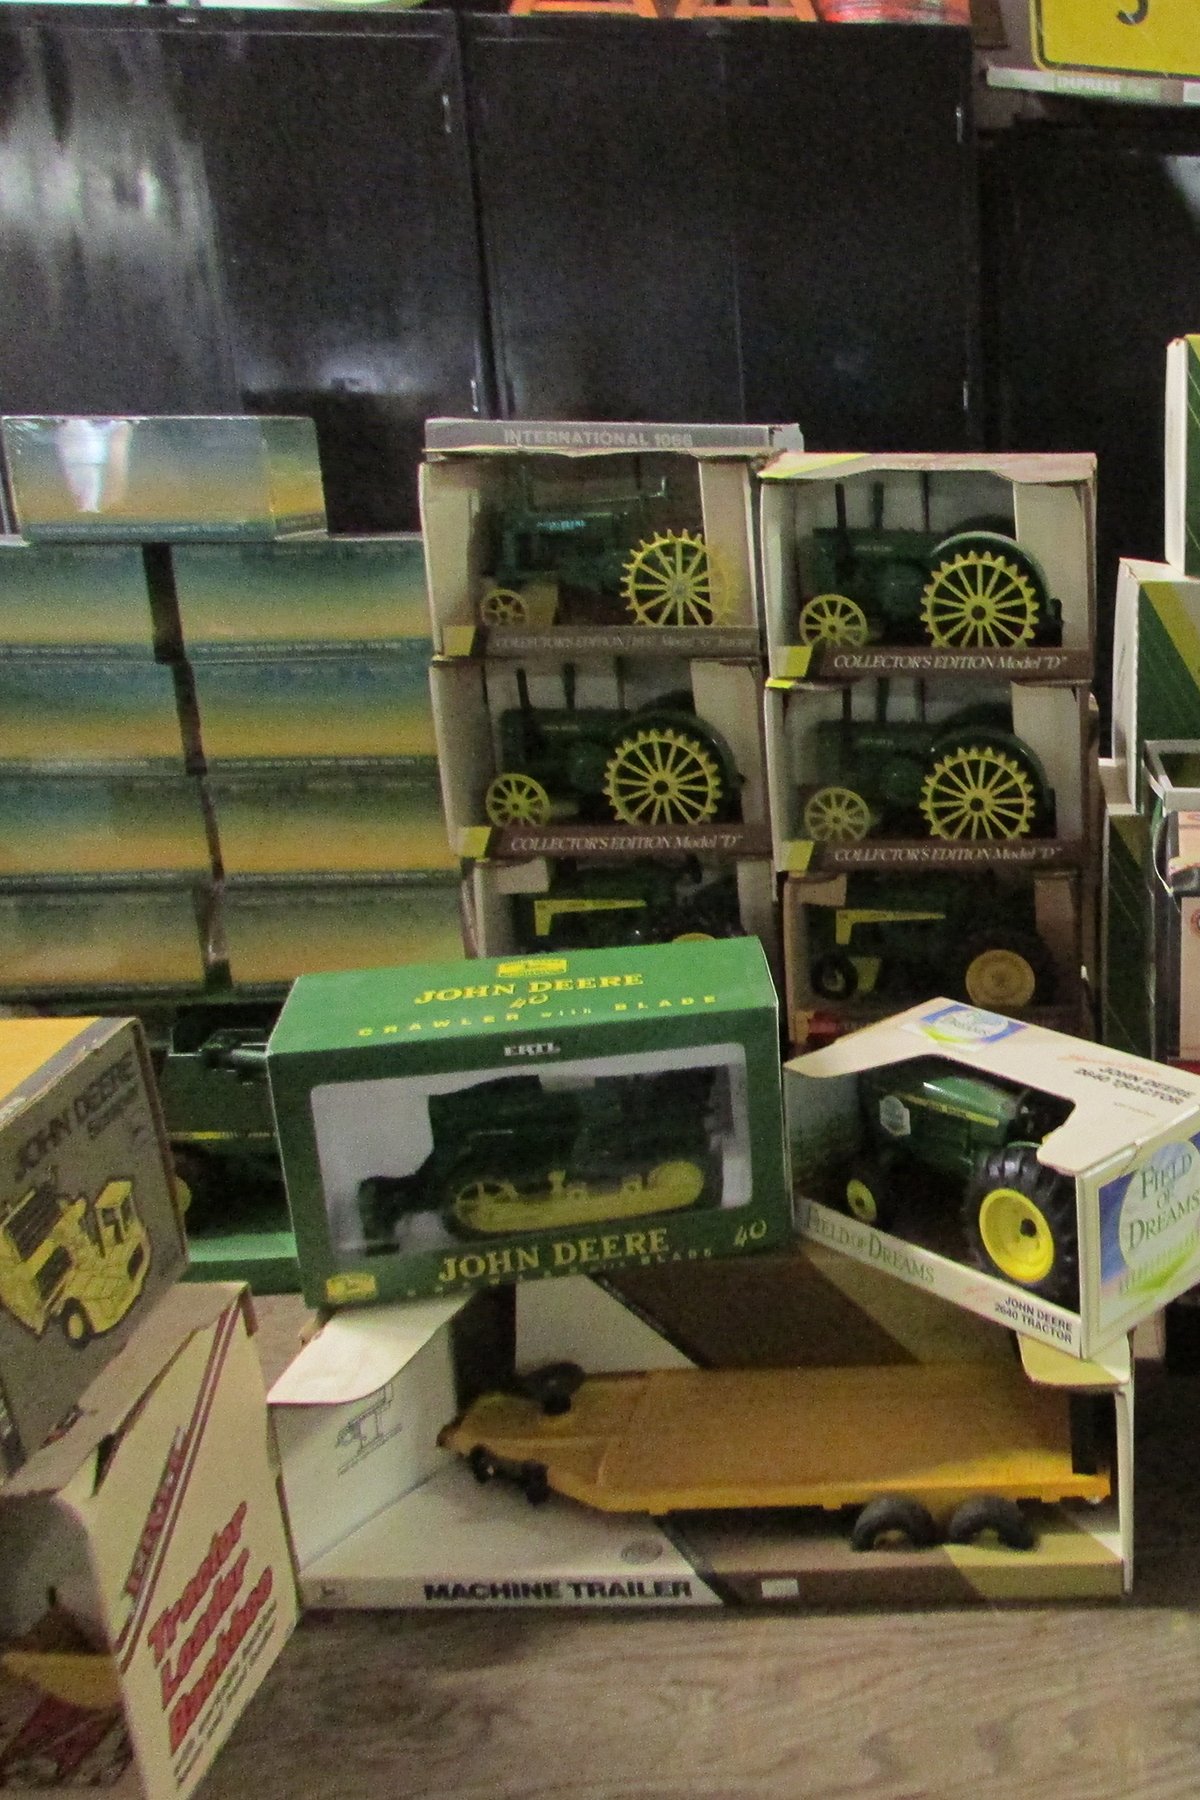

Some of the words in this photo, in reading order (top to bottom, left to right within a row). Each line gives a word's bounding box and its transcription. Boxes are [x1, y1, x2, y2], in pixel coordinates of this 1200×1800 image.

[504, 429, 649, 446] INTERNATIONAL
[833, 653, 933, 669] COLLECTOR'S
[933, 655, 995, 669] EDITION
[998, 655, 1042, 669] Model
[510, 836, 609, 851] COLLECTOR'S
[610, 837, 671, 850] EDITION
[675, 836, 718, 850] Model
[834, 848, 933, 862] COLLECTOR'S
[931, 848, 991, 862] EDITION
[995, 848, 1035, 861] Model
[414, 983, 516, 1005] JOHN
[528, 973, 645, 994] DEERE
[510, 993, 549, 1010] 40
[357, 1011, 521, 1037] CRAWLER
[613, 995, 717, 1012] BLADE
[504, 1042, 562, 1058] ERTL
[1140, 1152, 1193, 1200] FIELD
[1156, 1187, 1171, 1209] OF
[438, 1247, 540, 1283] JOHN
[553, 1229, 670, 1267] DEERE
[732, 1219, 768, 1248] 40
[806, 1203, 851, 1245] FIELD
[868, 1233, 934, 1285] DREAMS
[994, 1303, 1019, 1322] 2640
[1020, 1312, 1073, 1345] TRACTOR
[1003, 1295, 1035, 1317] JOHN
[1036, 1309, 1073, 1331] DEERE
[424, 1581, 560, 1600] MACHINE
[567, 1581, 692, 1598] TRAILER
